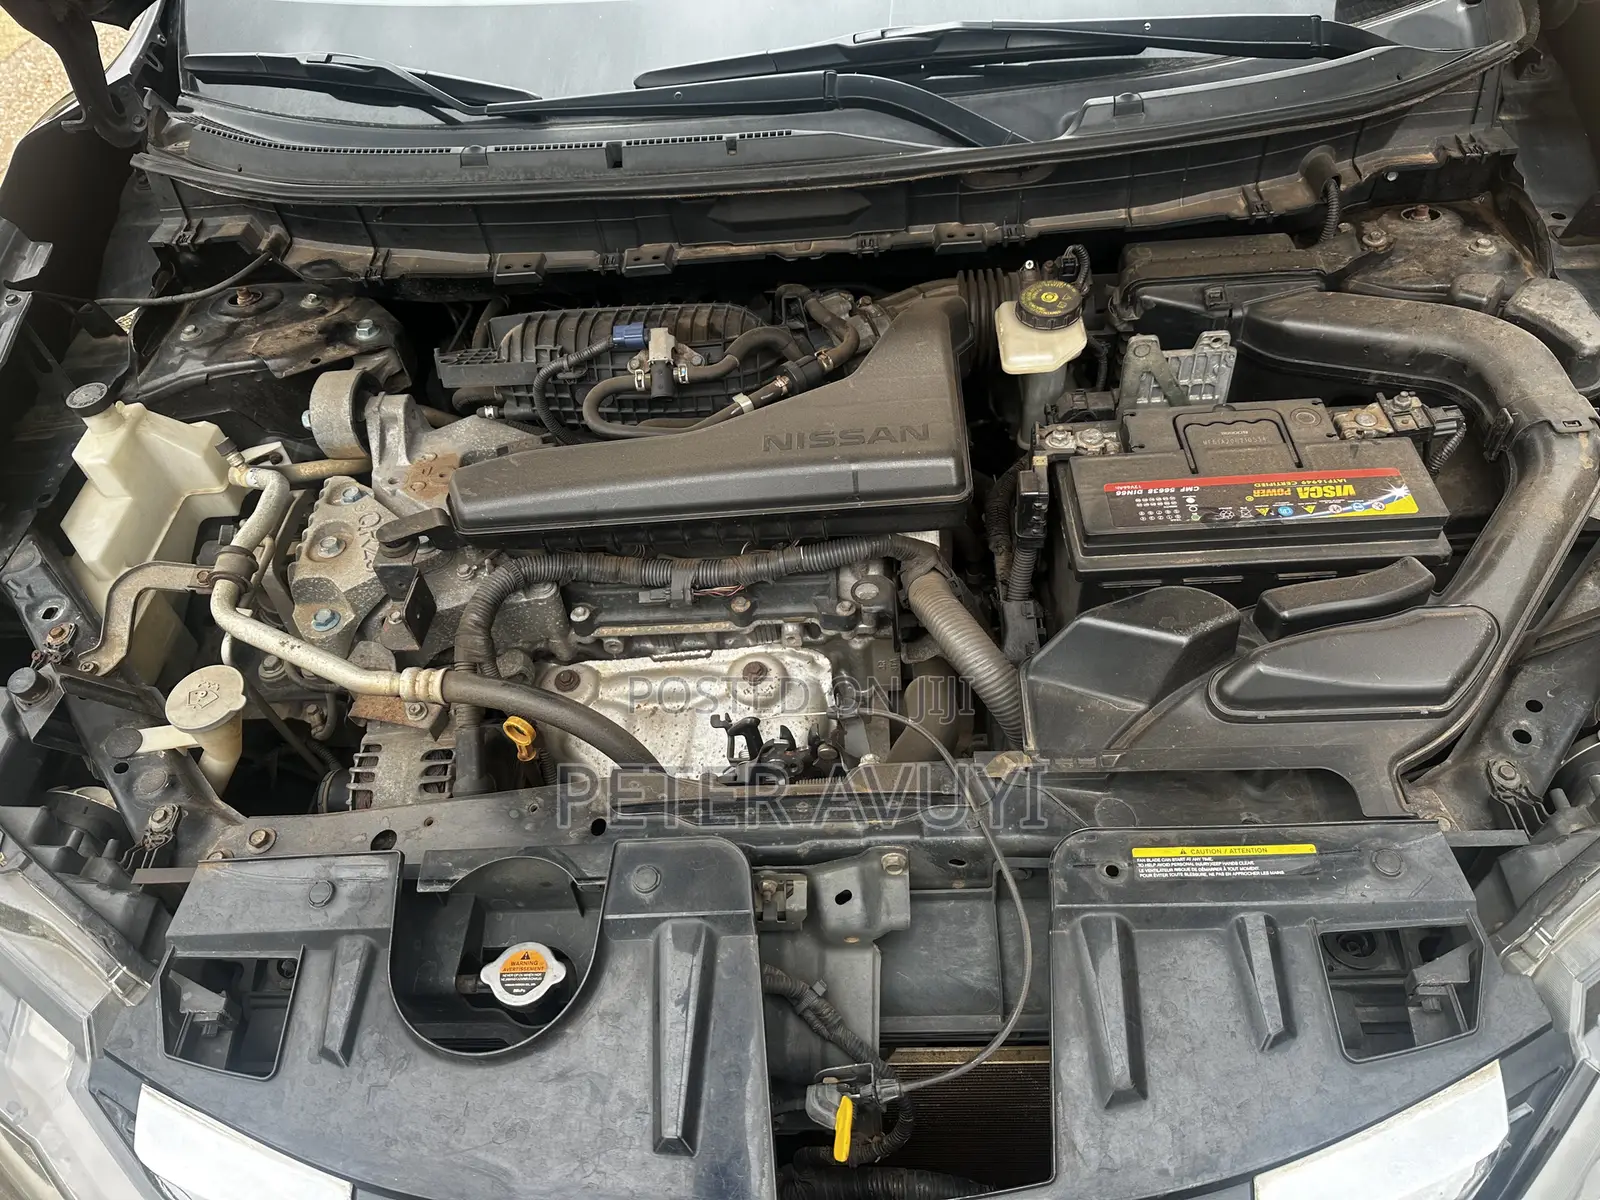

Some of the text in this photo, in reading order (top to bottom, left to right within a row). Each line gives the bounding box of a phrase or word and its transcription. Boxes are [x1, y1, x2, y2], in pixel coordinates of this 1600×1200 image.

[763, 423, 930, 452] NISSAN
[1253, 485, 1356, 499] VISCA POWER
